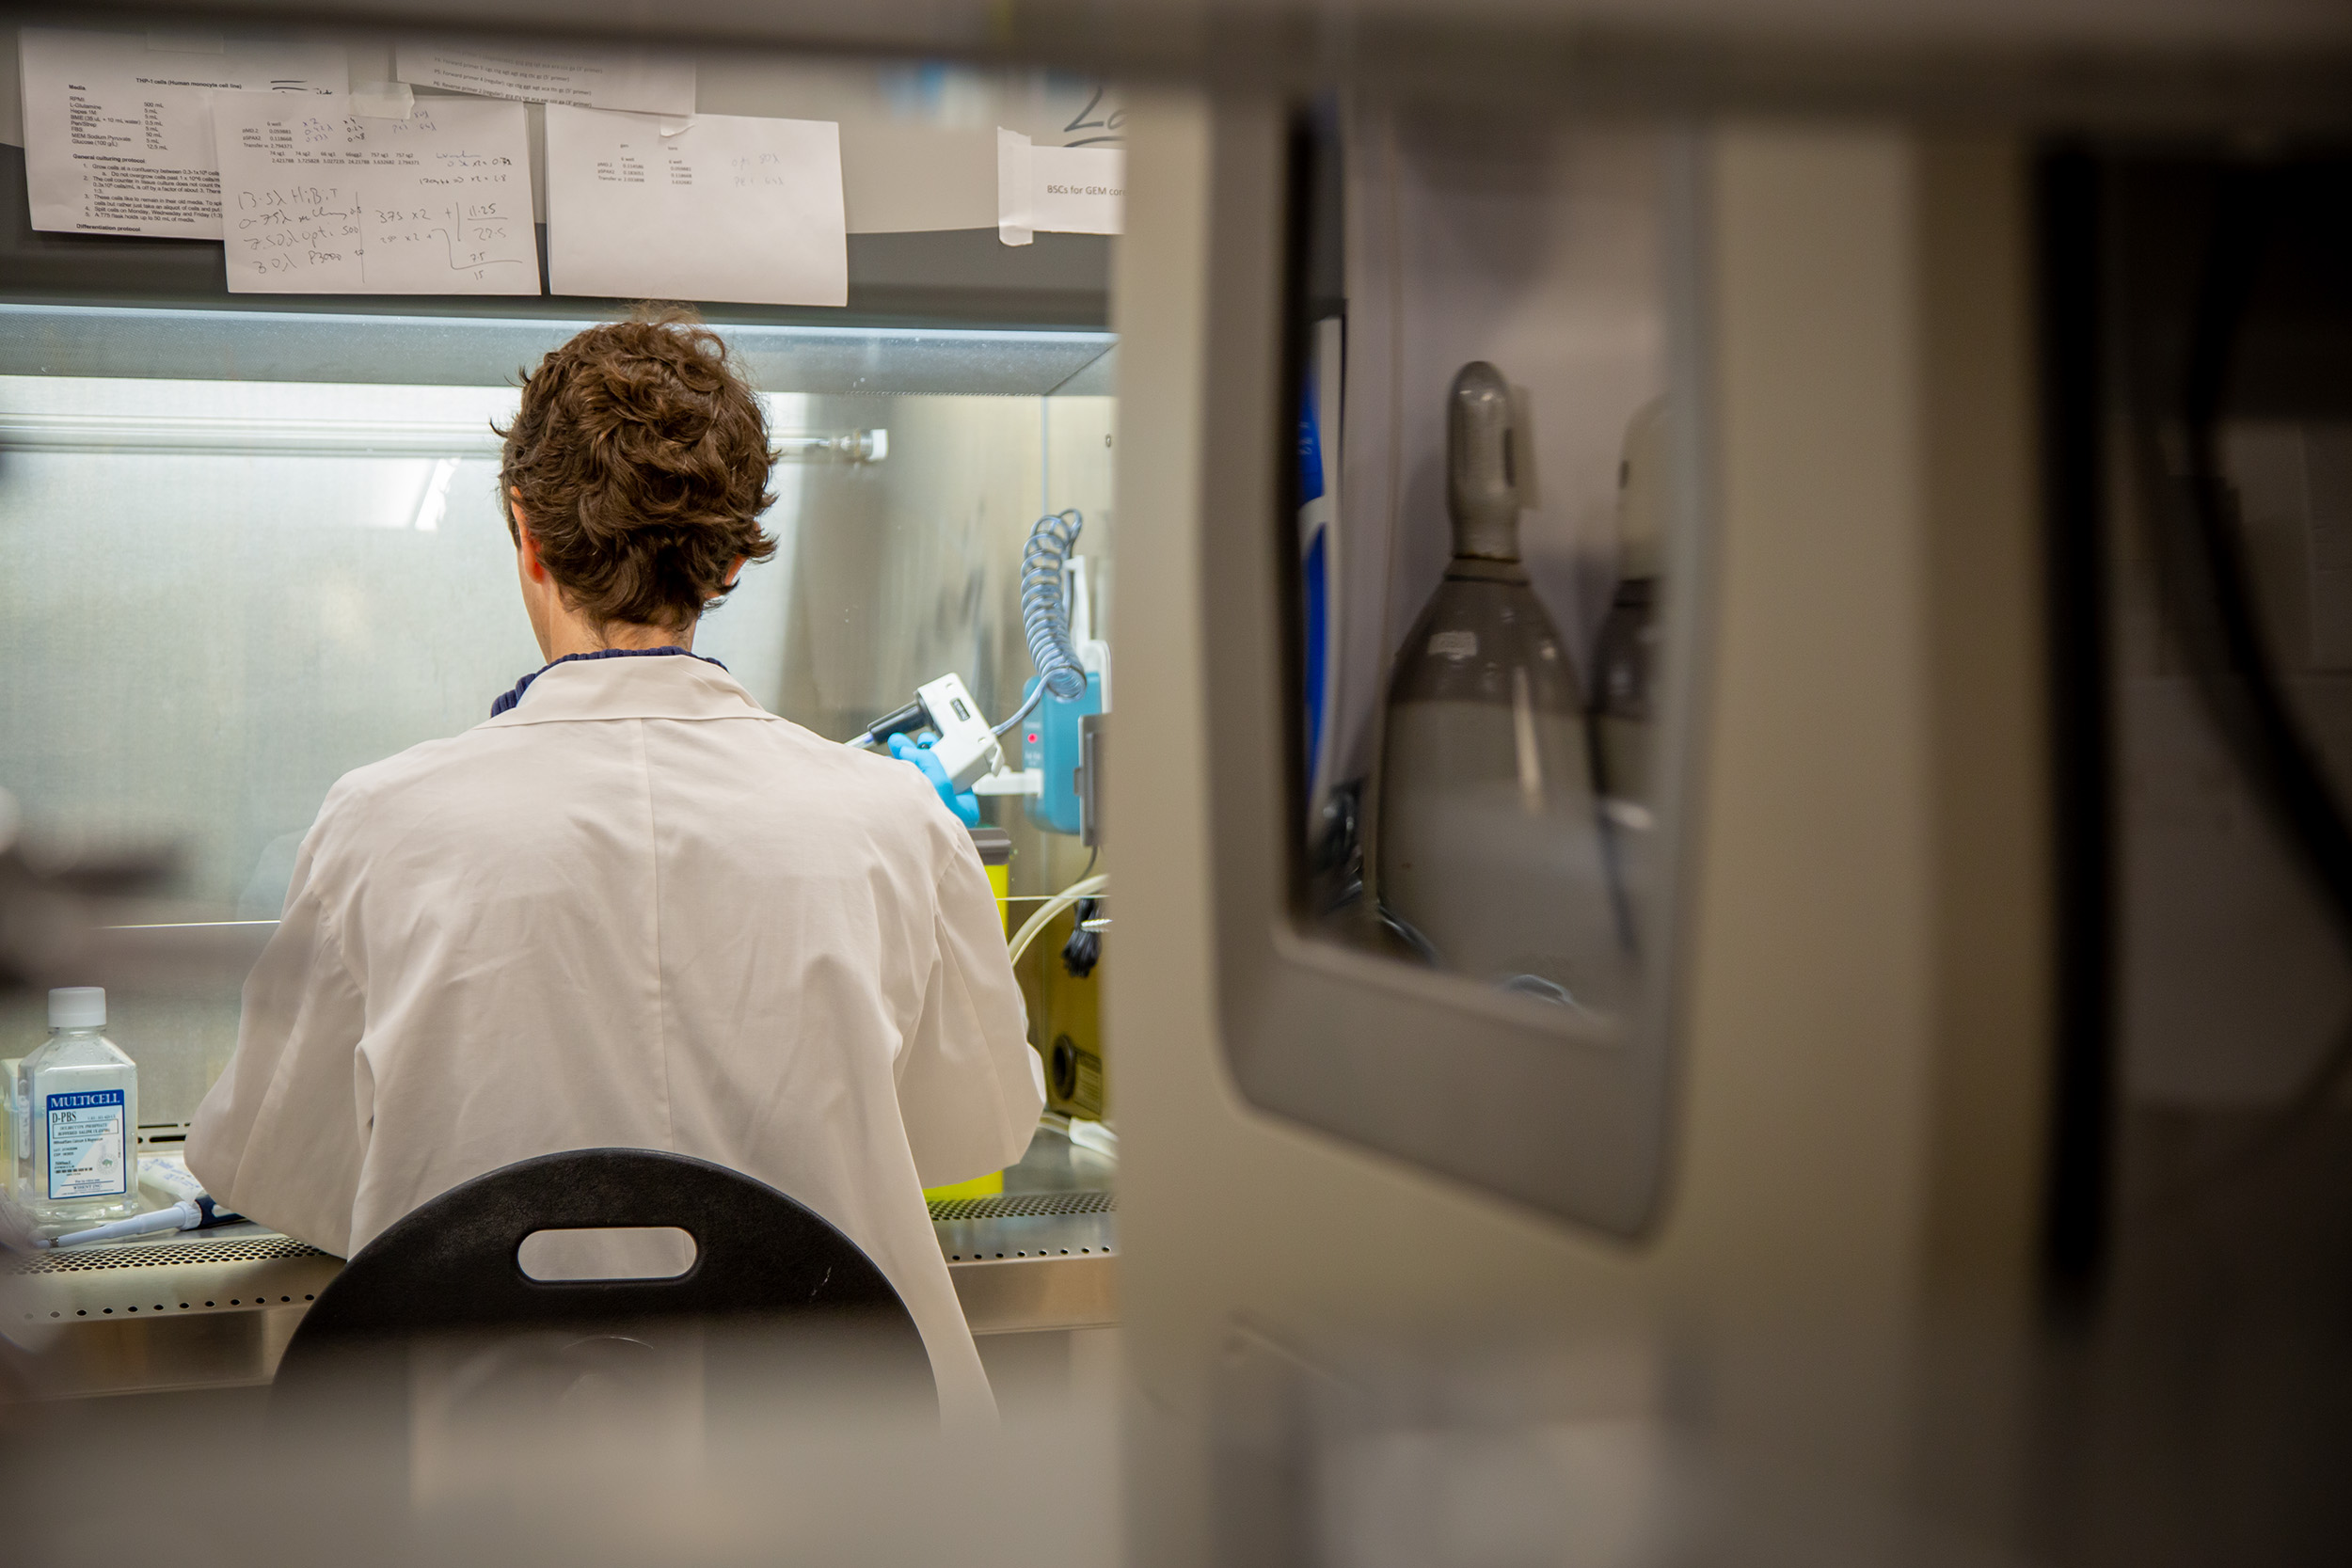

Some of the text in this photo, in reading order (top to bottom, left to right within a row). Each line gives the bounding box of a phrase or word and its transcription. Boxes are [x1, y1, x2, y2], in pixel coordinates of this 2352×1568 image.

[443, 71, 462, 79] Forward
[1047, 185, 1068, 194] BSCs
[1071, 185, 1083, 194] for
[1086, 186, 1106, 195] GEM
[51, 1093, 119, 1108] MULTICELL
[53, 1112, 76, 1123] D-PBS
